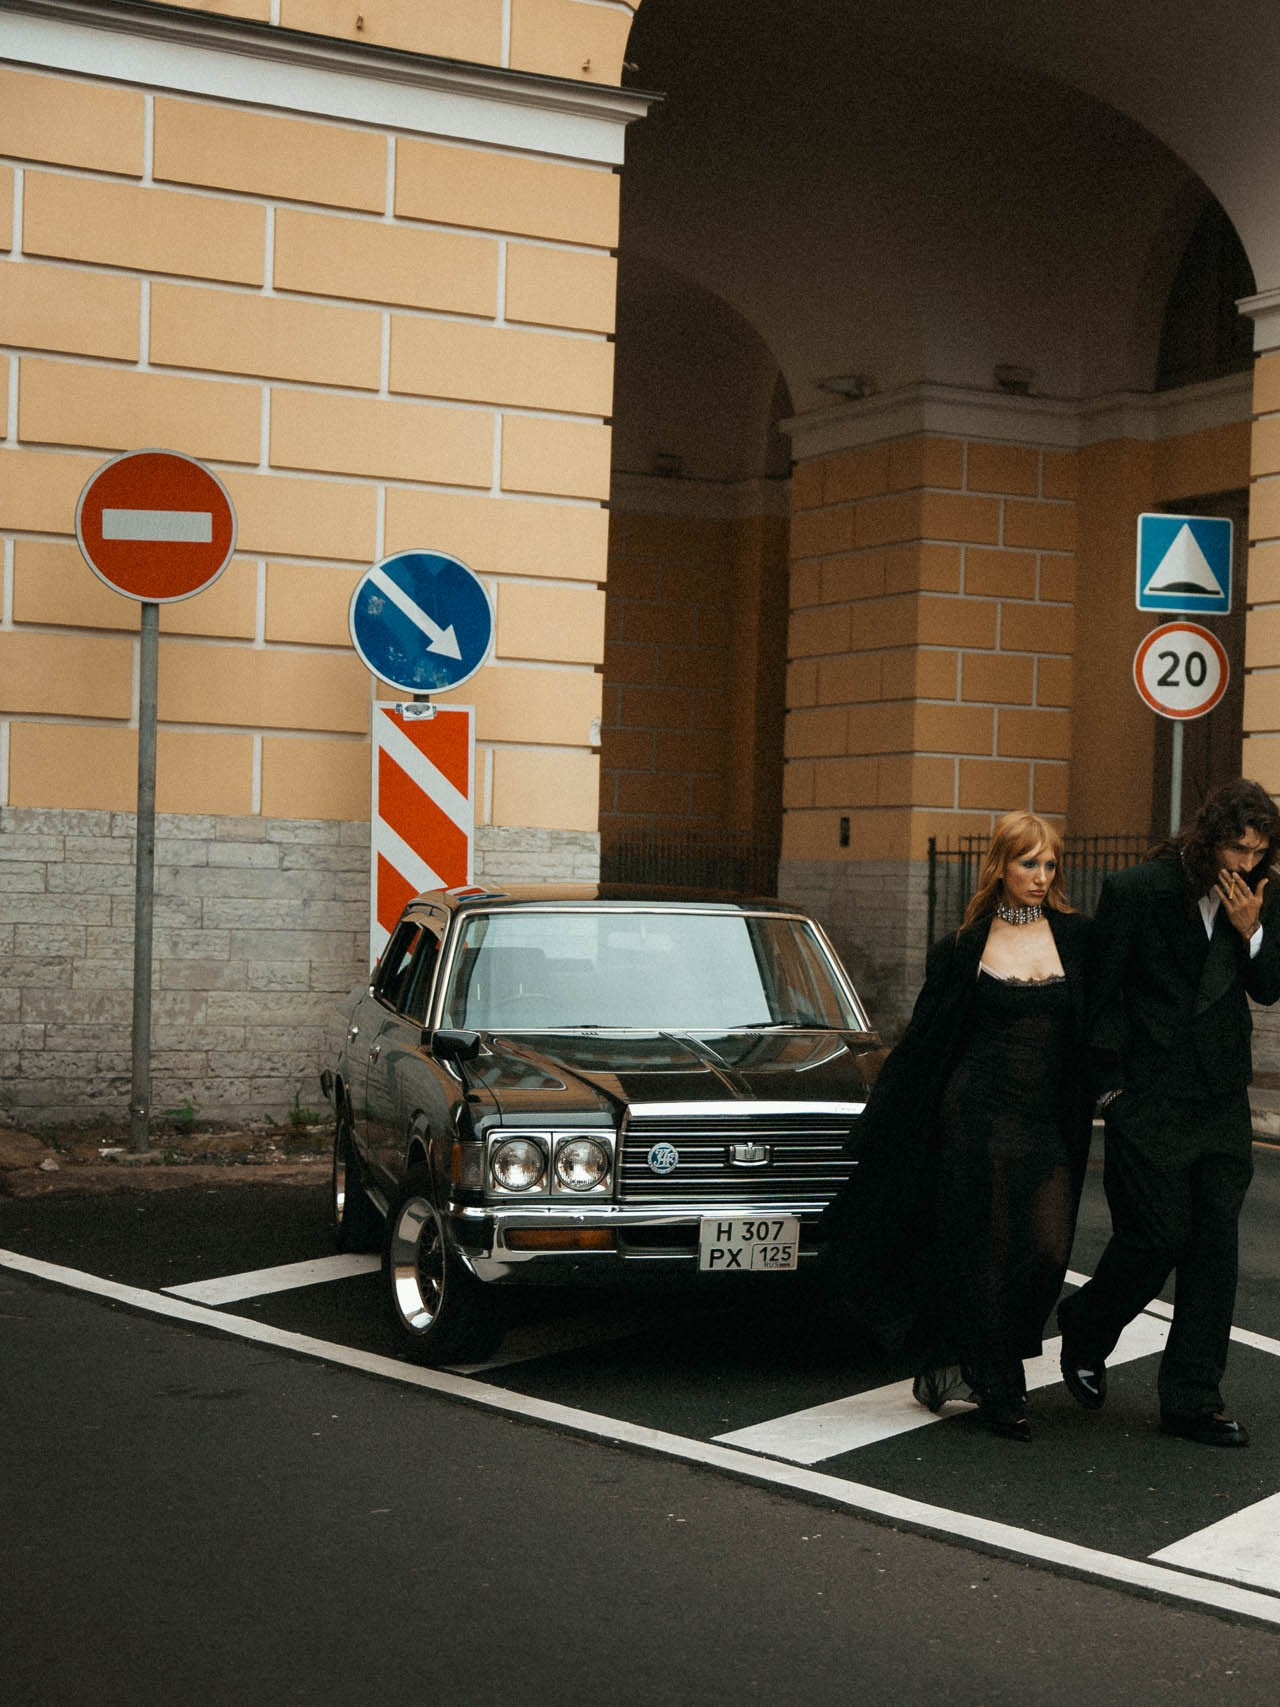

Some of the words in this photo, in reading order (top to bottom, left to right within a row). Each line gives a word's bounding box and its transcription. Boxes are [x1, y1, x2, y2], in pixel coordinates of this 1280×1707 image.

[1157, 651, 1207, 687] 20
[716, 1222, 732, 1241] H
[741, 1221, 784, 1241] 307
[709, 1248, 743, 1268] PX
[760, 1246, 792, 1261] 125
